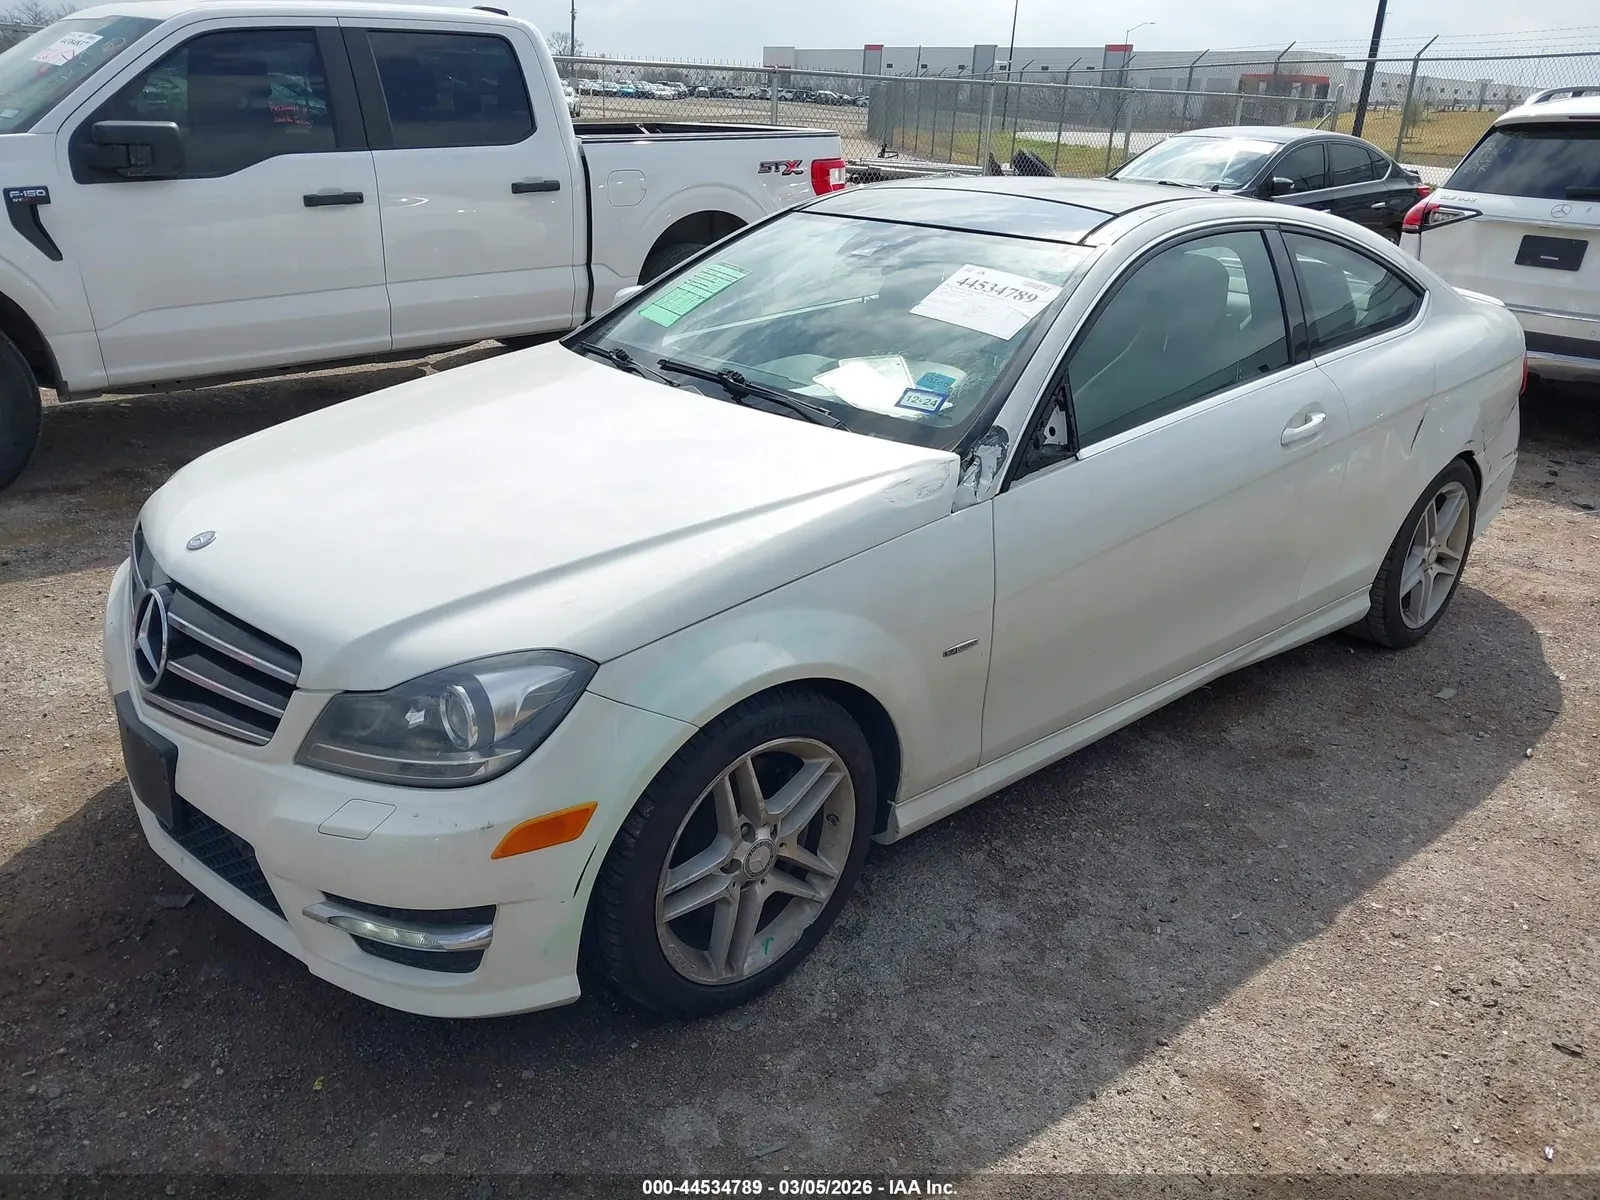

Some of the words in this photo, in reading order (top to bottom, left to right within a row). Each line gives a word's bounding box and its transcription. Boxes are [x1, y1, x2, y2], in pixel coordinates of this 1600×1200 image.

[758, 159, 804, 176] STX
[9, 189, 46, 198] F-150
[956, 276, 1040, 304] 44534789
